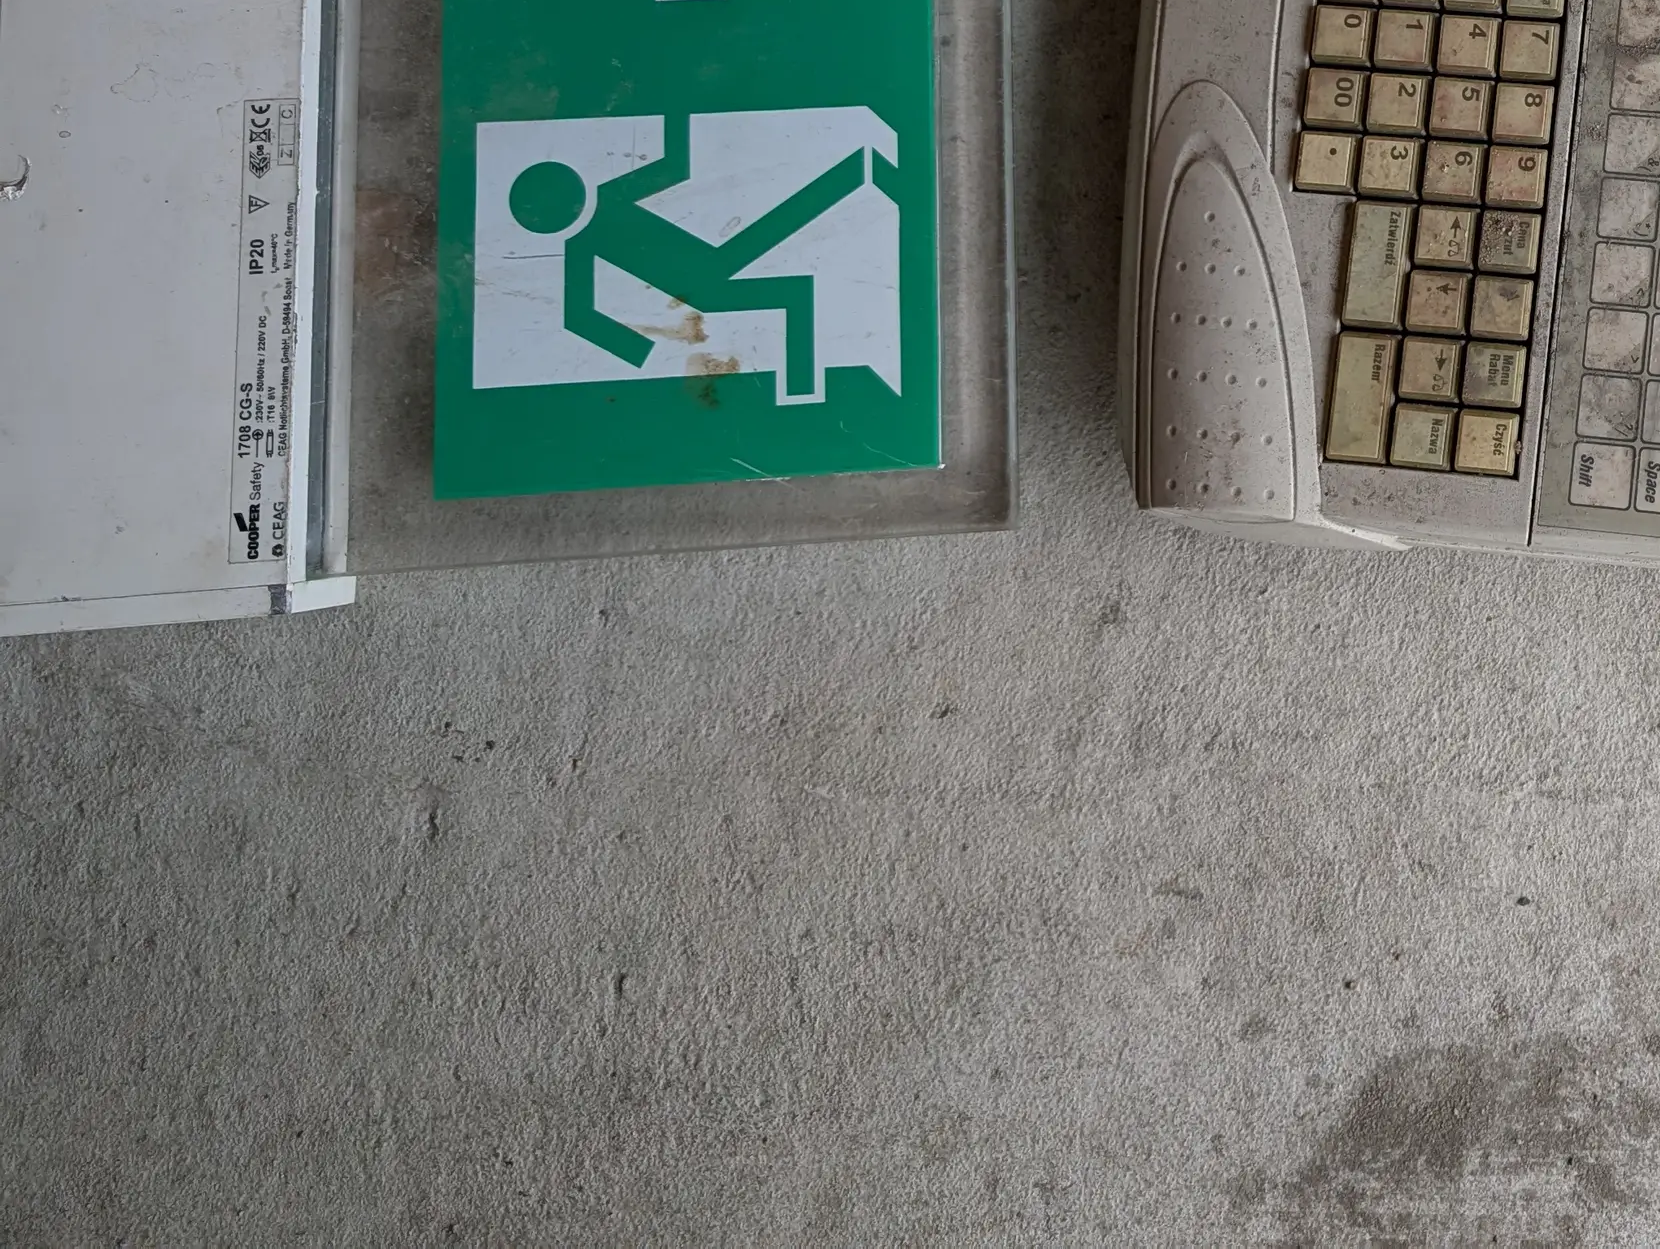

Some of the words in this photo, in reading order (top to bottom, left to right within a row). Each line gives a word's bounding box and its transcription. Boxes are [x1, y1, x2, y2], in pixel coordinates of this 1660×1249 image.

[1343, 14, 1361, 28] 0
[1405, 22, 1423, 31] 1
[1469, 24, 1487, 39] 4
[1532, 30, 1549, 45] 7
[1333, 77, 1355, 107] 00
[1398, 83, 1417, 98] 2
[1461, 86, 1480, 101] 5
[1524, 93, 1543, 107] 8
[1390, 146, 1408, 161] 3
[1454, 151, 1472, 166] 6
[1517, 156, 1536, 171] 9
[1384, 211, 1401, 266] Zatwierdź
[1517, 221, 1530, 249] Cena
[249, 239, 265, 275] IP20
[1371, 343, 1386, 383] Razem
[1487, 353, 1500, 387] Rabat
[1500, 354, 1514, 386] Menu
[239, 383, 253, 422] CG-S
[238, 425, 251, 459] 1708
[1428, 418, 1444, 455] Nazwa
[1491, 423, 1507, 456] Czyść
[250, 462, 265, 501] Safety
[1579, 454, 1594, 488] Shift
[247, 503, 260, 560] COOPER
[273, 501, 285, 541] CEAG
